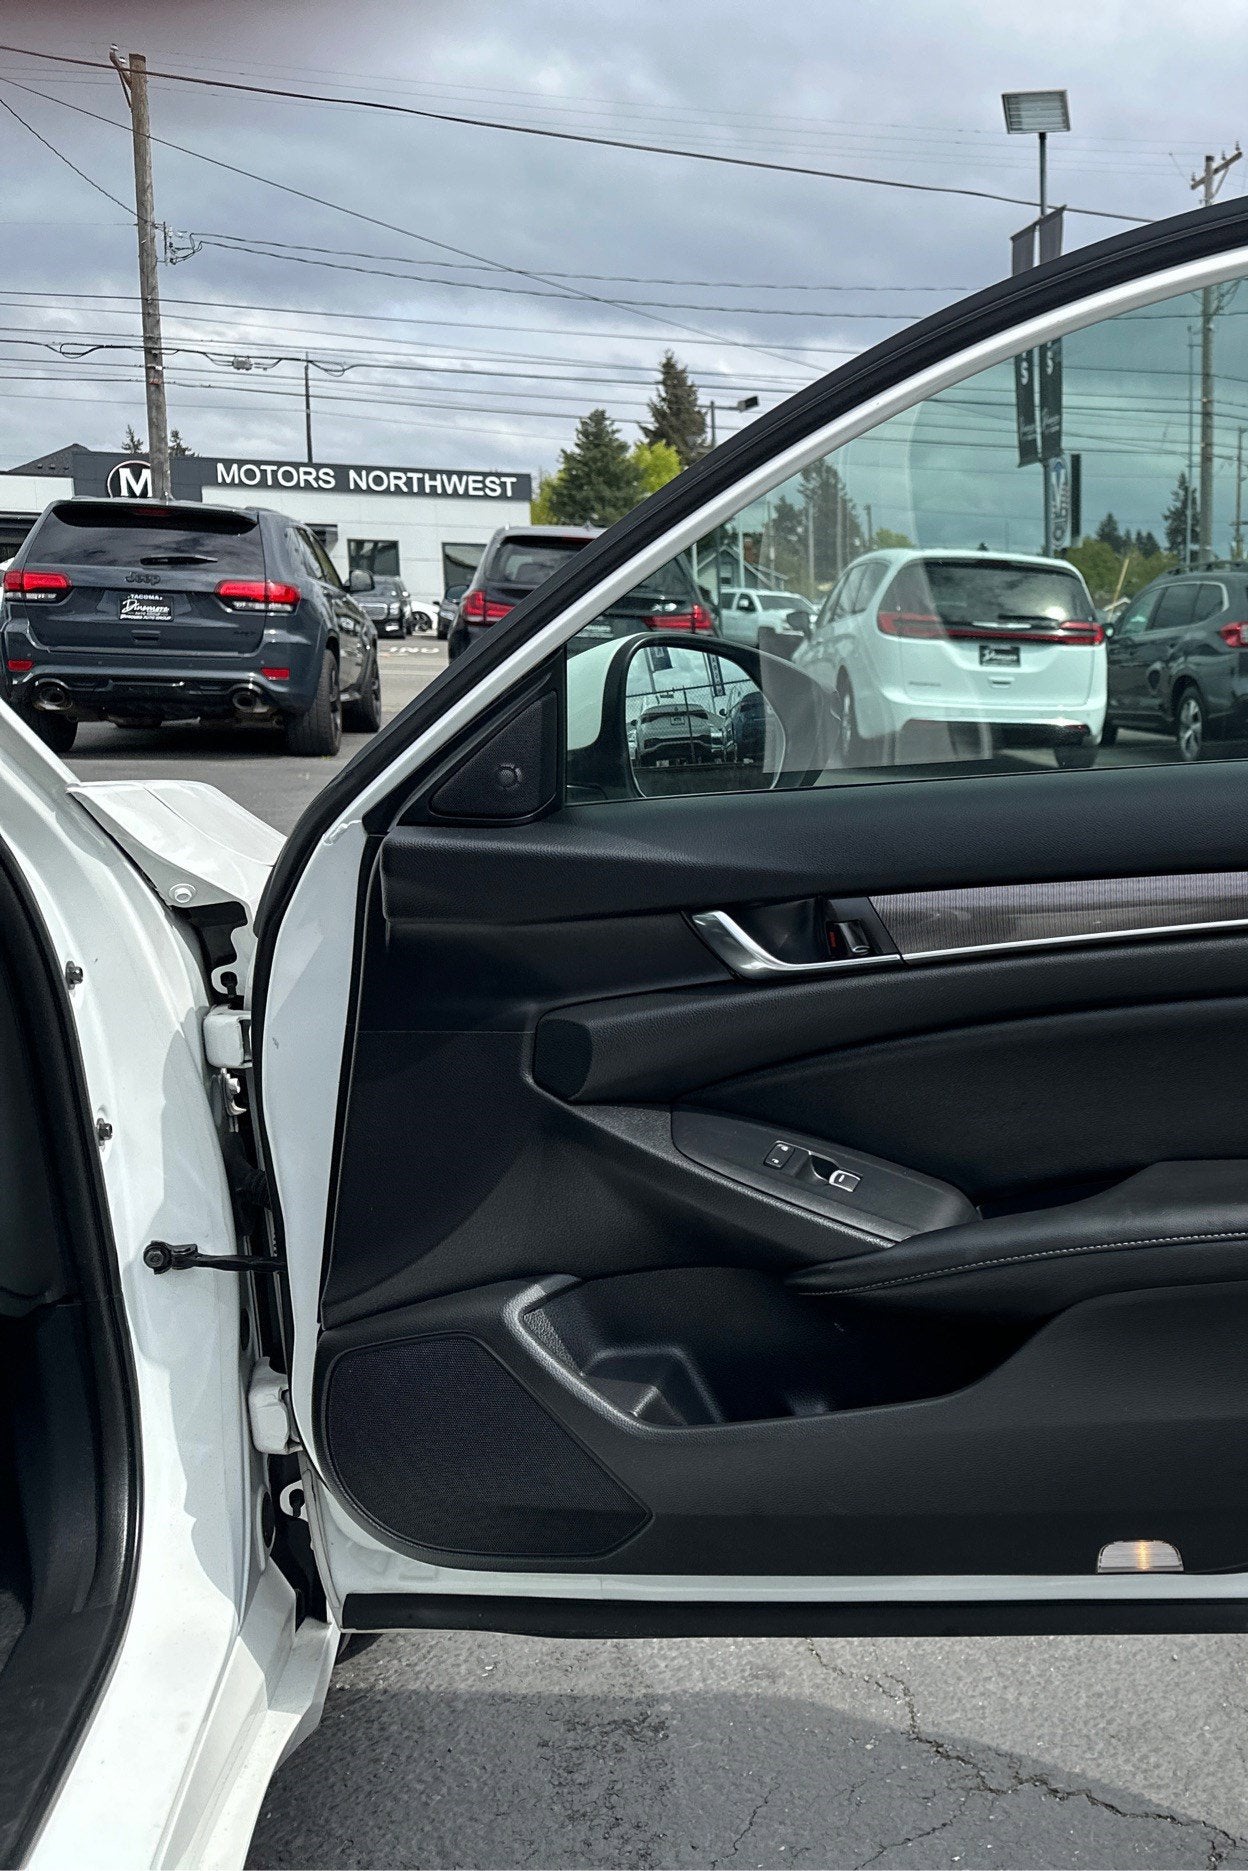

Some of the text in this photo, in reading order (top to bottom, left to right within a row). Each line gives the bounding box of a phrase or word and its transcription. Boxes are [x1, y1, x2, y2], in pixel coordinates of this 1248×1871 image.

[216, 462, 518, 498] MOTORS NORTHWEST
[125, 571, 161, 586] Jeep
